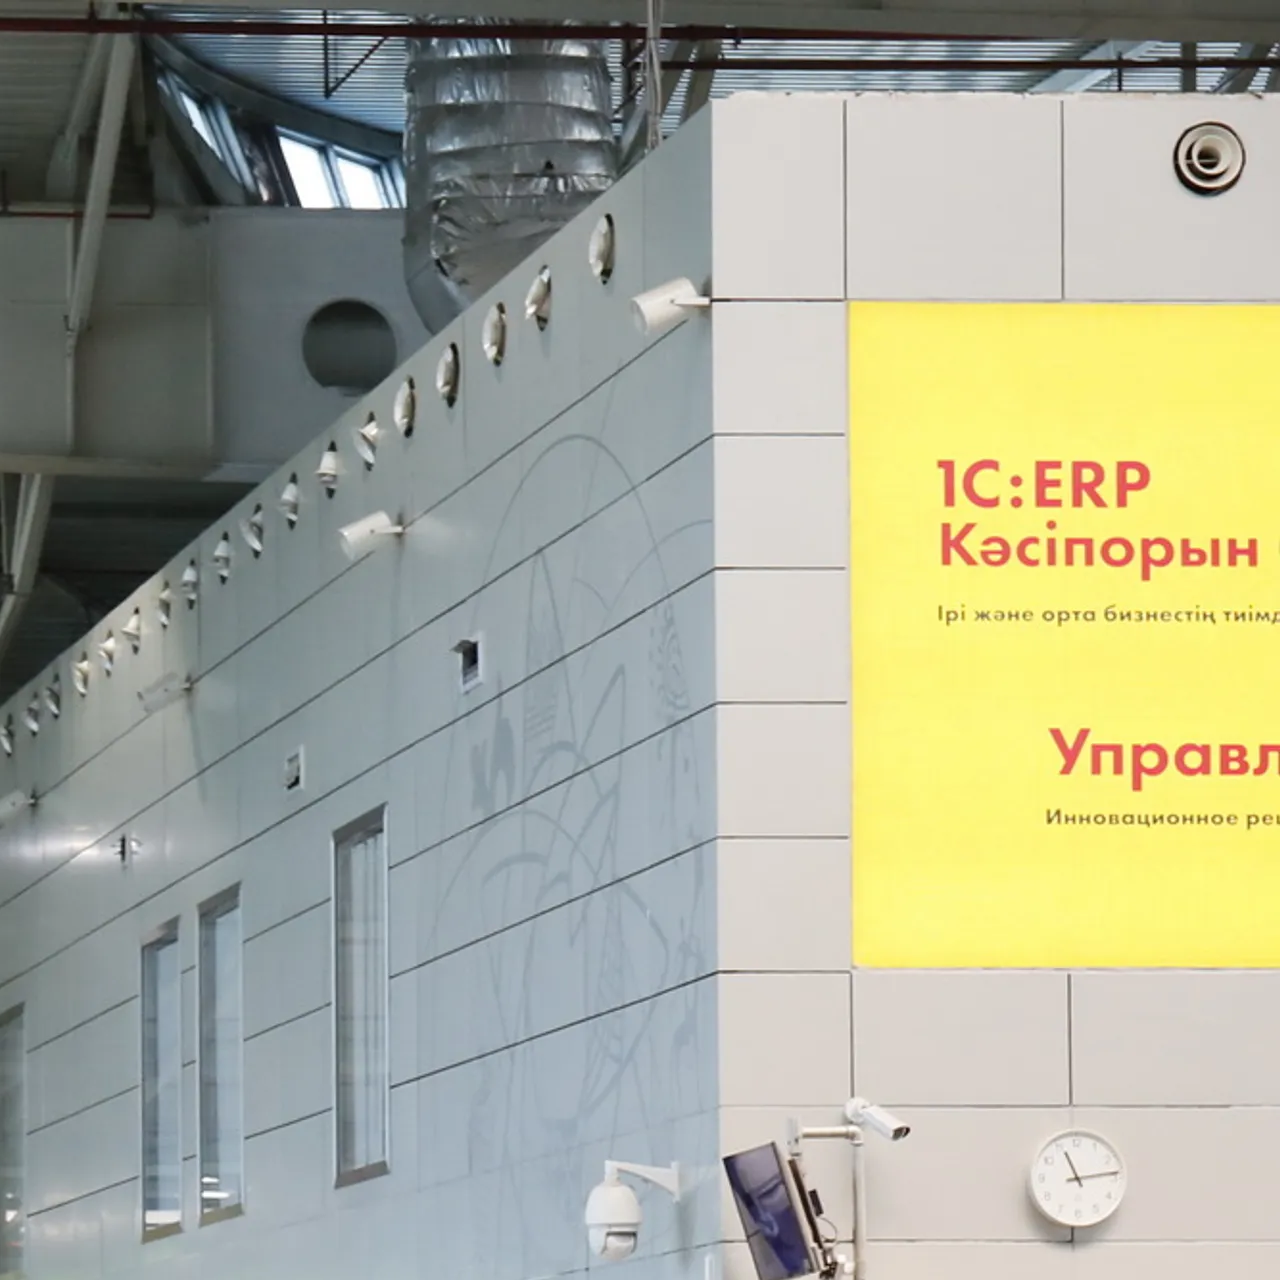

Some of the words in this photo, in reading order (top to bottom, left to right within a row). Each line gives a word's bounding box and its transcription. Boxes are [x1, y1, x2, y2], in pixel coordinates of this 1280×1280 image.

[937, 459, 1151, 509] 1C:ERP
[940, 521, 1258, 581] Кәсіпорын
[938, 606, 966, 623] Ірі
[974, 609, 1034, 622] және
[1042, 609, 1096, 625] орта
[1104, 604, 1216, 624] бизнестің
[1046, 811, 1239, 826] Инновационное
[1073, 1139, 1081, 1147] 12
